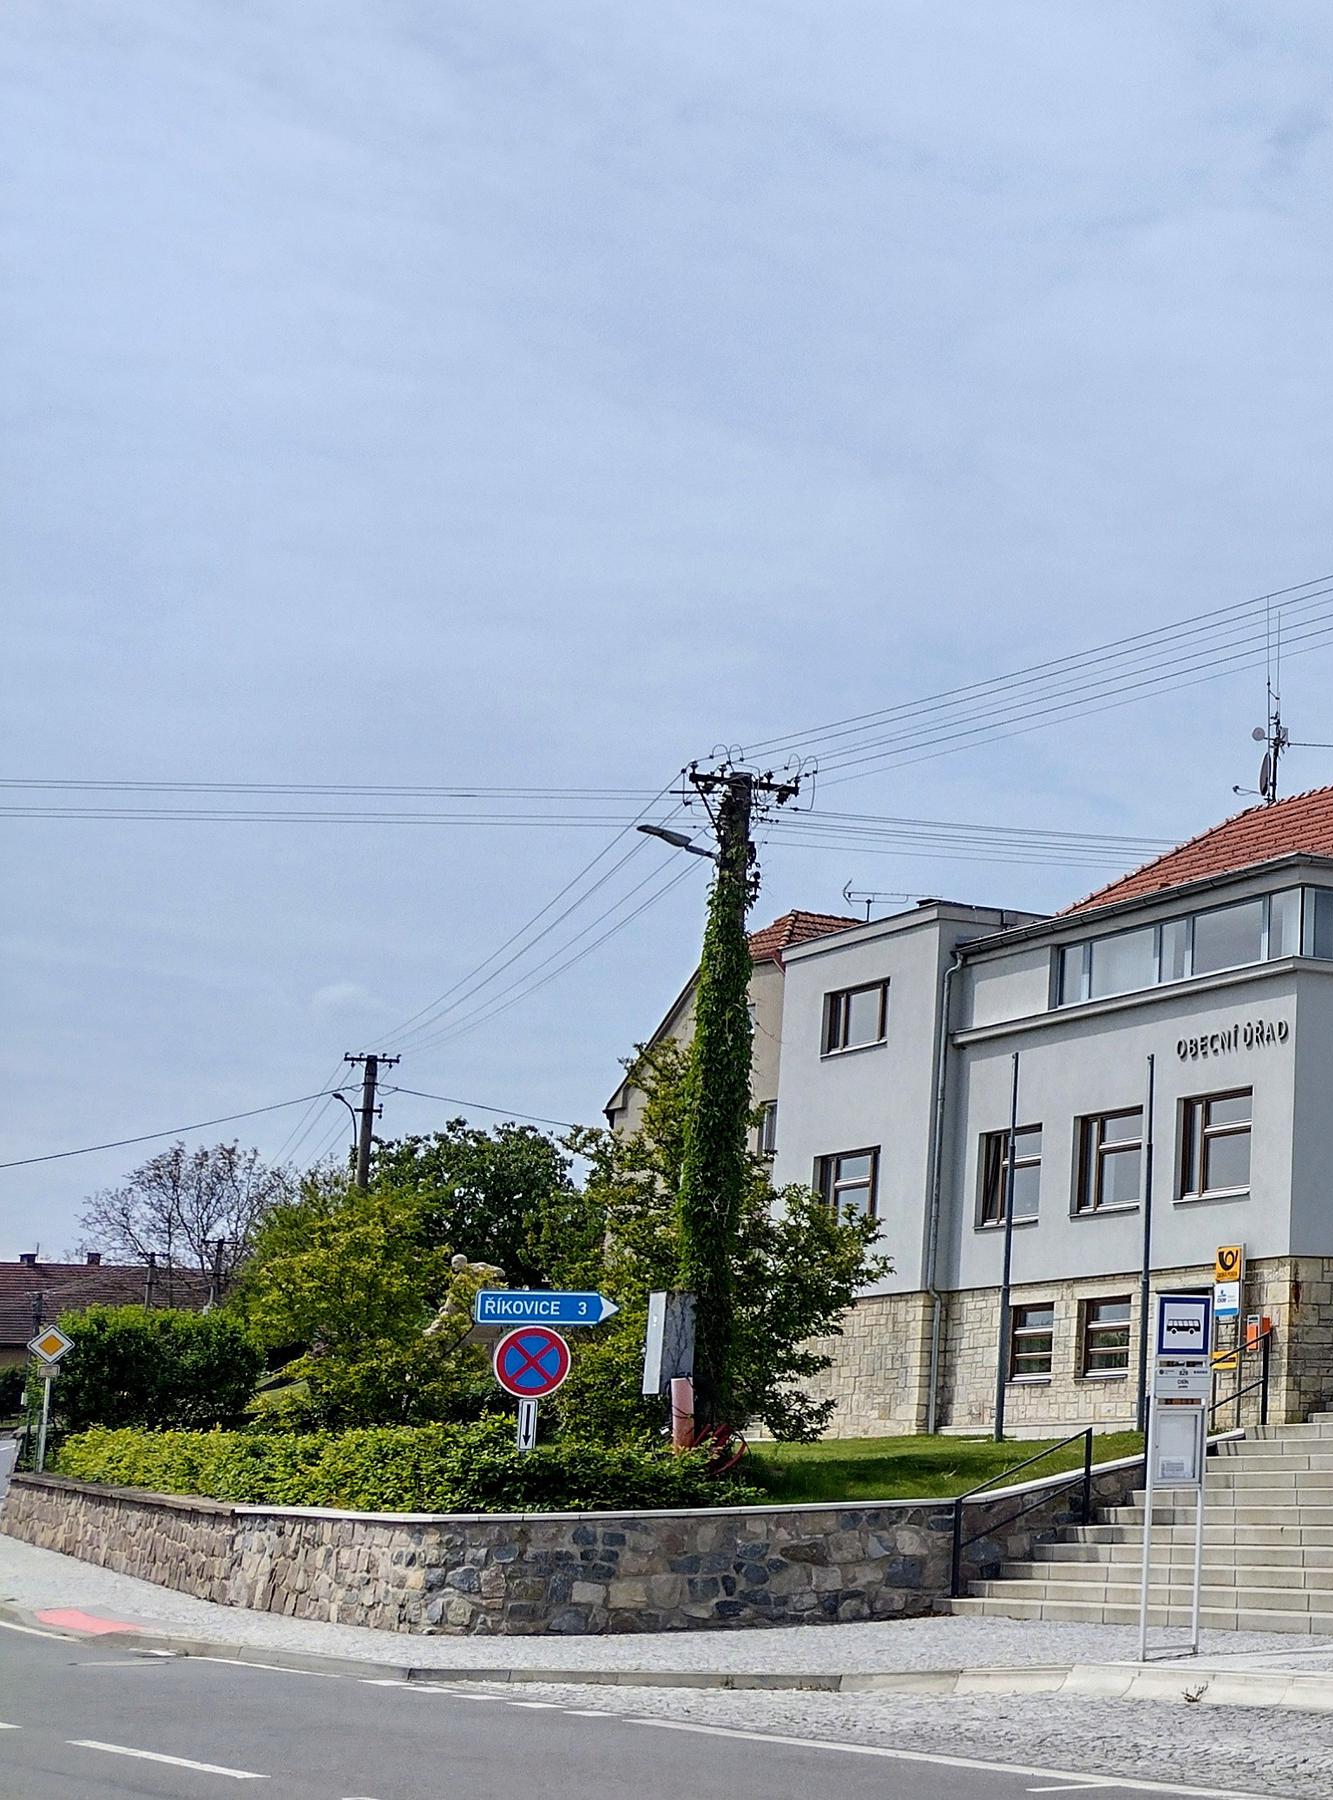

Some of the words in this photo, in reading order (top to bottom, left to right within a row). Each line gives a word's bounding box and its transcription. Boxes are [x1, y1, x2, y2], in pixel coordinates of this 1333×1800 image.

[1176, 1023, 1239, 1060] OBECNÍ
[1243, 1019, 1289, 1048] ÚŘAD
[484, 1296, 561, 1315] ŘÍKOVICE
[578, 1301, 588, 1315] 3
